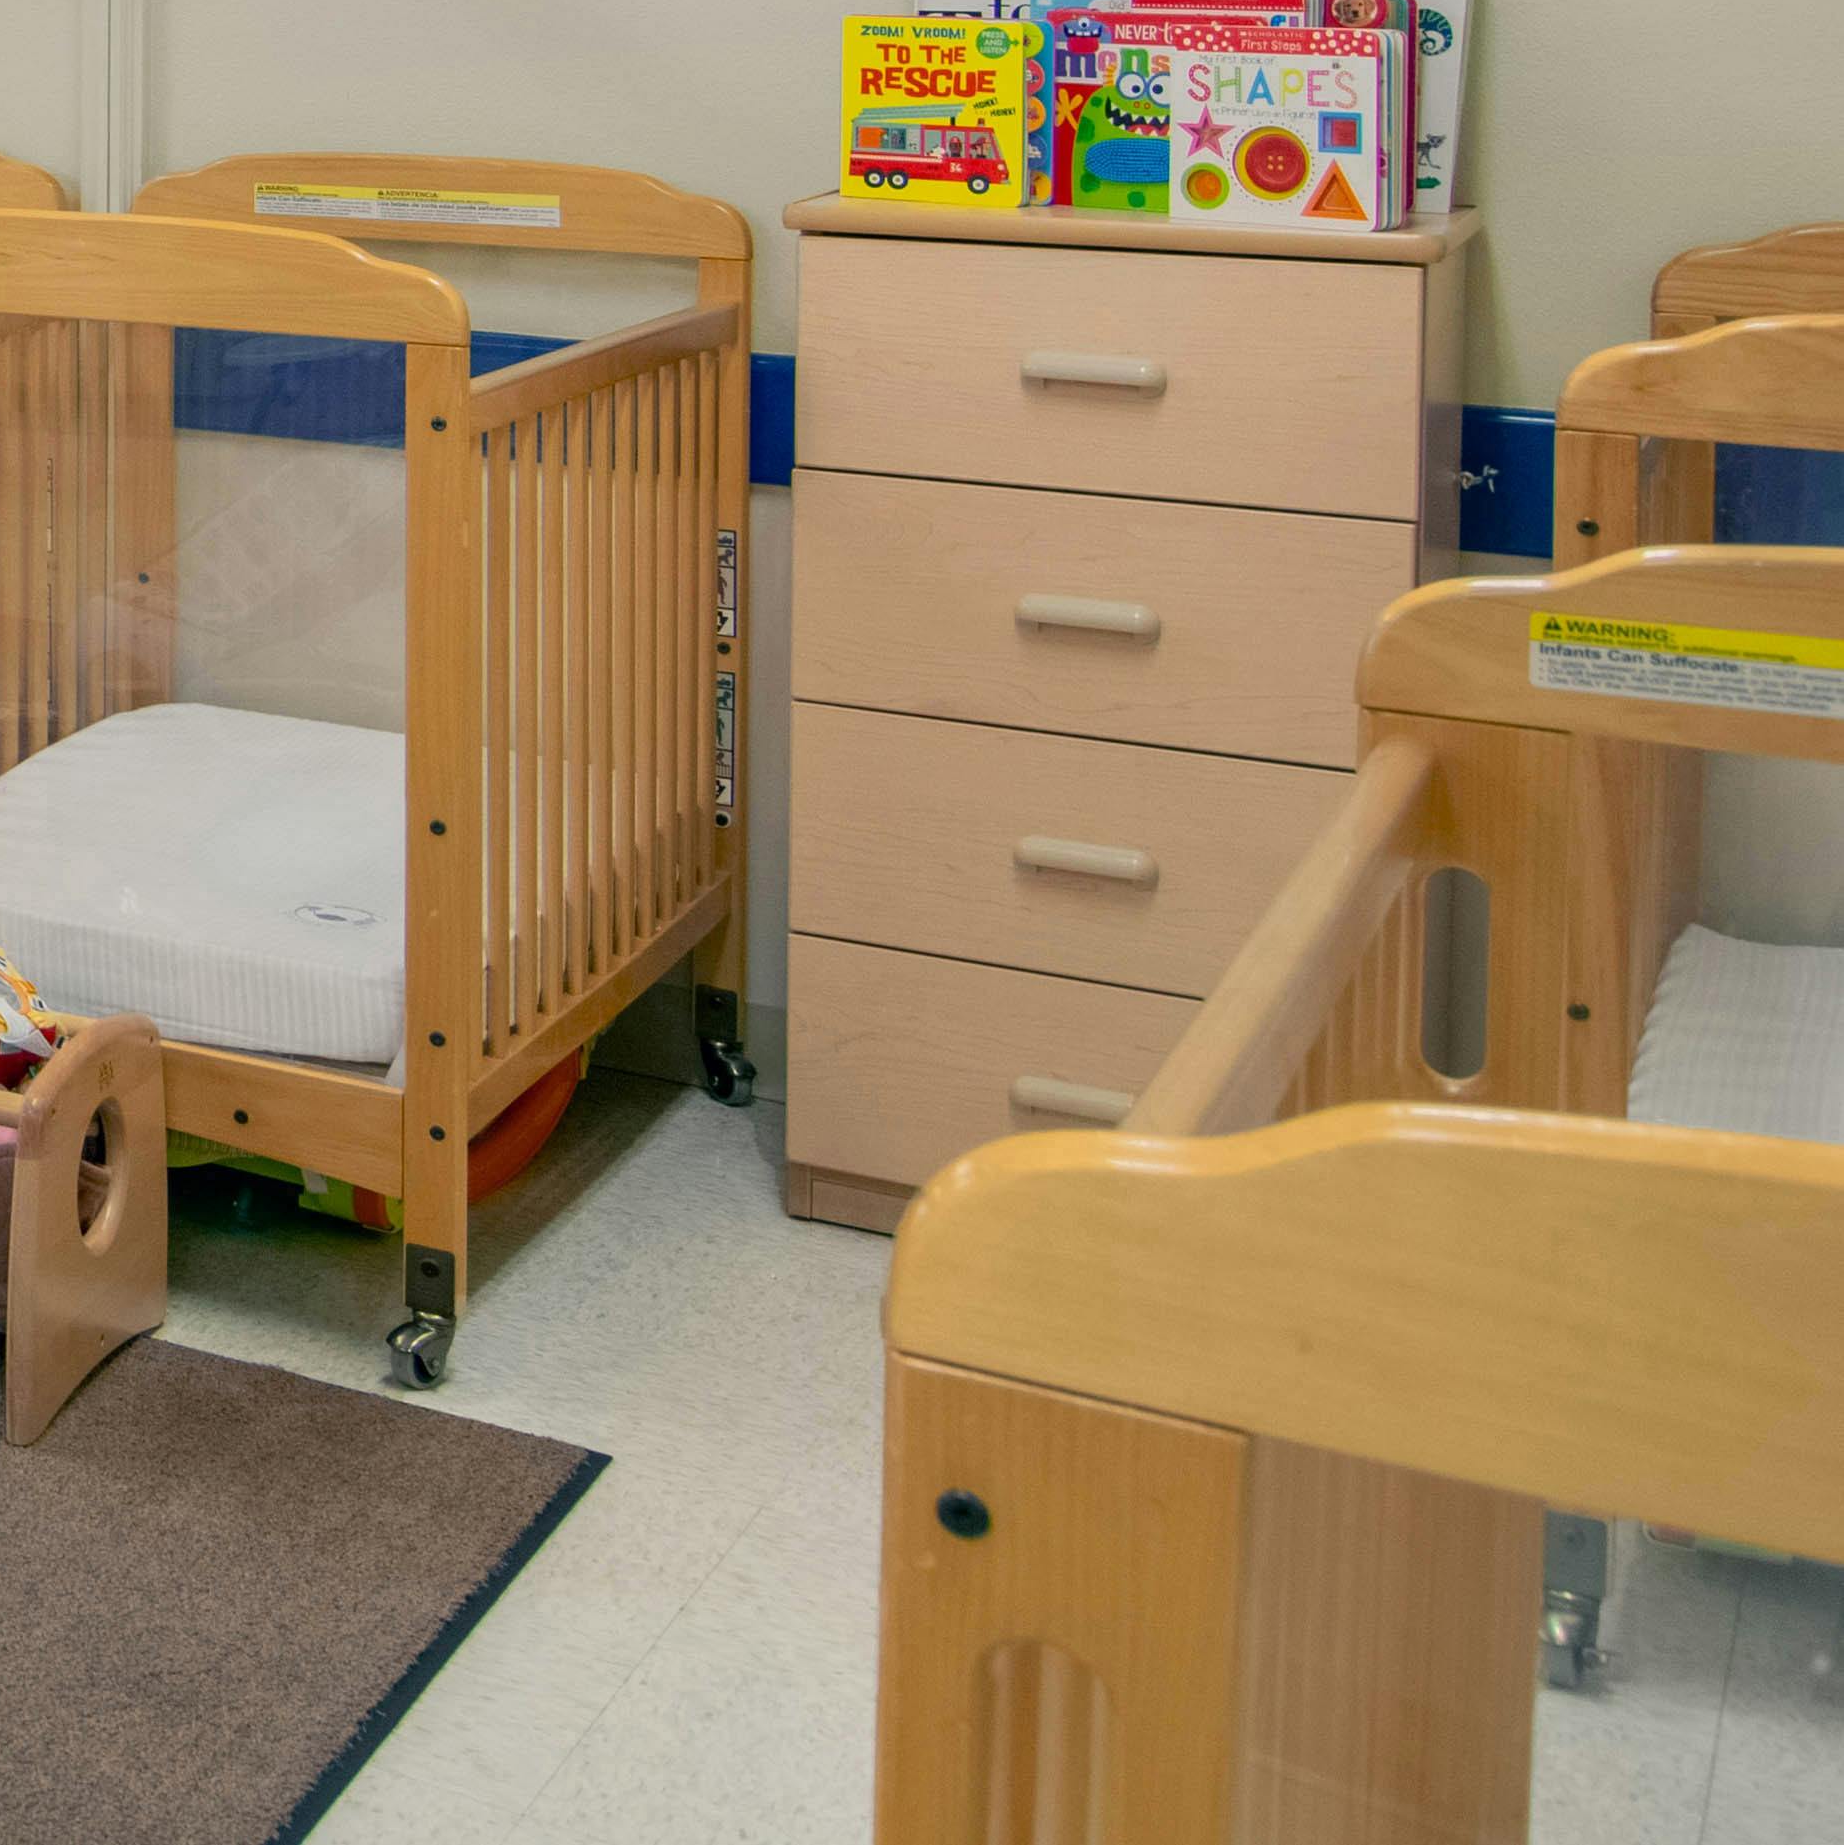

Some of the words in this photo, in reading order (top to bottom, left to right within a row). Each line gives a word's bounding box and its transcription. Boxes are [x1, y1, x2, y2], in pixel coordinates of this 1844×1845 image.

[860, 24, 905, 38] ZOOM!
[911, 25, 967, 40] VROOM!
[1113, 23, 1158, 42] NEVER
[876, 42, 912, 65] TO
[918, 44, 968, 65] THE
[1240, 38, 1269, 51] First
[859, 66, 997, 99] RESCUE
[1186, 62, 1359, 111] SHAPES
[1538, 642, 1603, 661] Infants
[1607, 649, 1645, 665] Can
